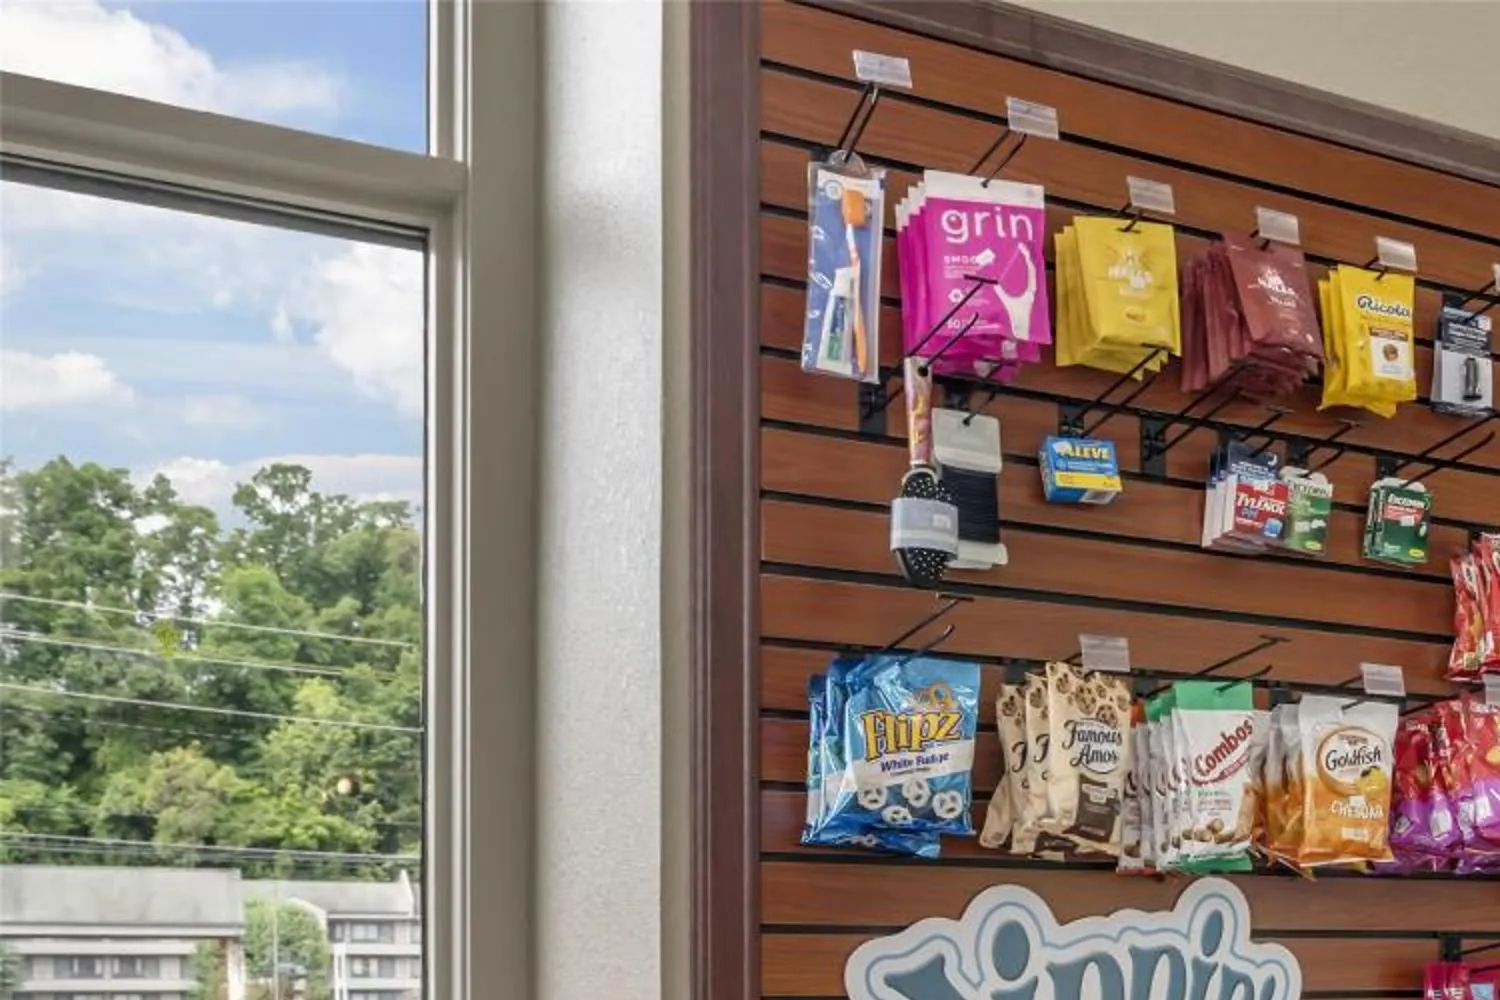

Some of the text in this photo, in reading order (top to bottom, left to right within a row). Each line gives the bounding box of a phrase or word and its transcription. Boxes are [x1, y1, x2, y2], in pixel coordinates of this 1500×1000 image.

[941, 206, 1034, 245] grin
[1357, 295, 1410, 317] Ricola
[1061, 719, 1123, 750] Famous
[1195, 719, 1254, 777] Combos
[880, 757, 914, 773] White
[1069, 743, 1120, 768] Amos
[1325, 745, 1382, 772] Goldfish
